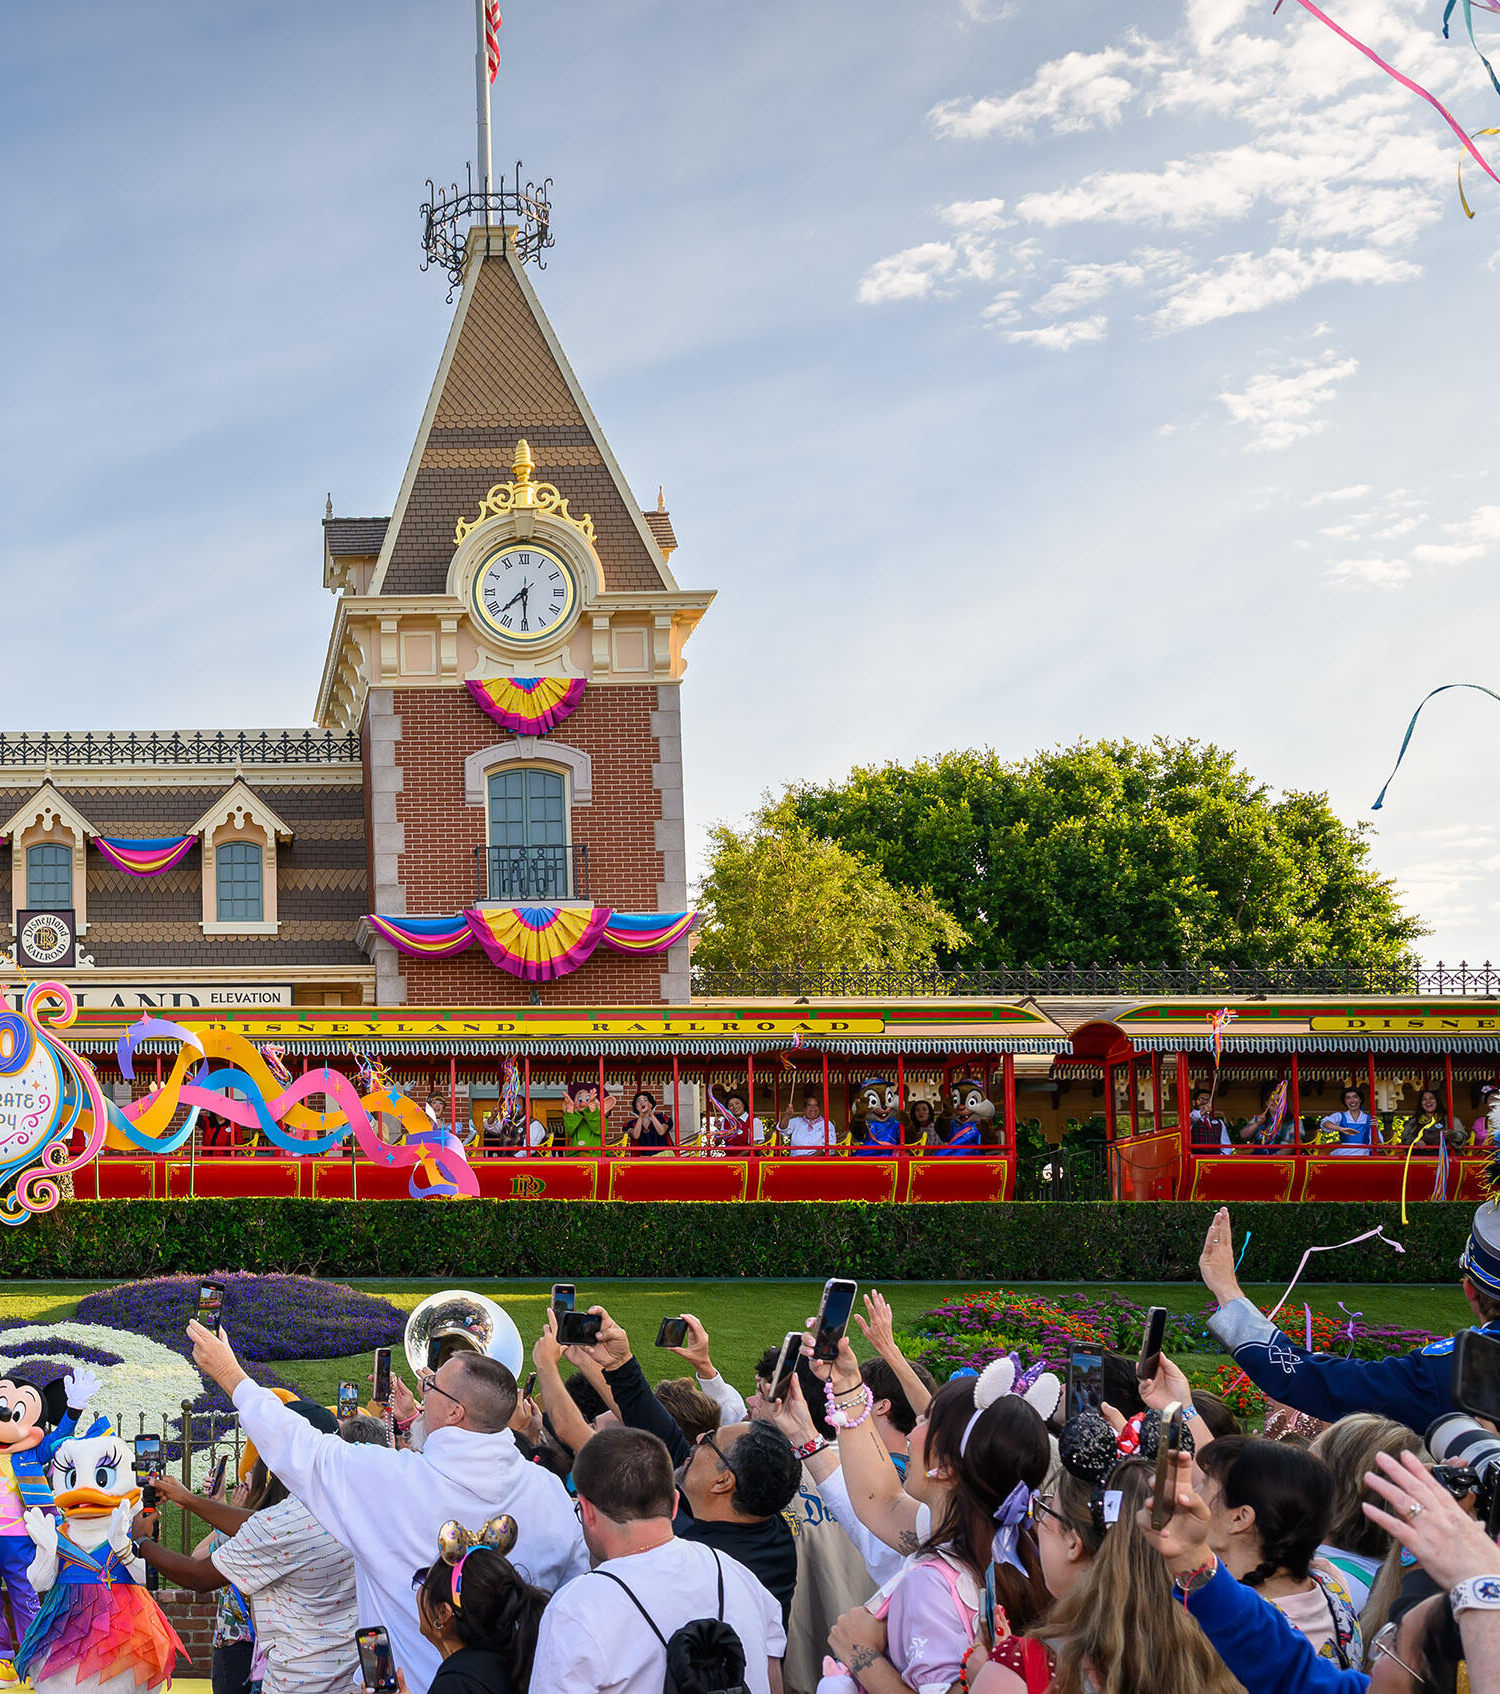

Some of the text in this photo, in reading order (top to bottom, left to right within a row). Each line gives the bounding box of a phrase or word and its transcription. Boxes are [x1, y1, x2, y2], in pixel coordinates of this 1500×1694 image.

[22, 916, 70, 938] Disneyland
[25, 943, 67, 961] RAILROAD
[210, 992, 281, 1004] ELEVATION
[209, 1022, 850, 1032] DISNEYLAND RAILROAD
[1346, 1019, 1496, 1028] DISNE
